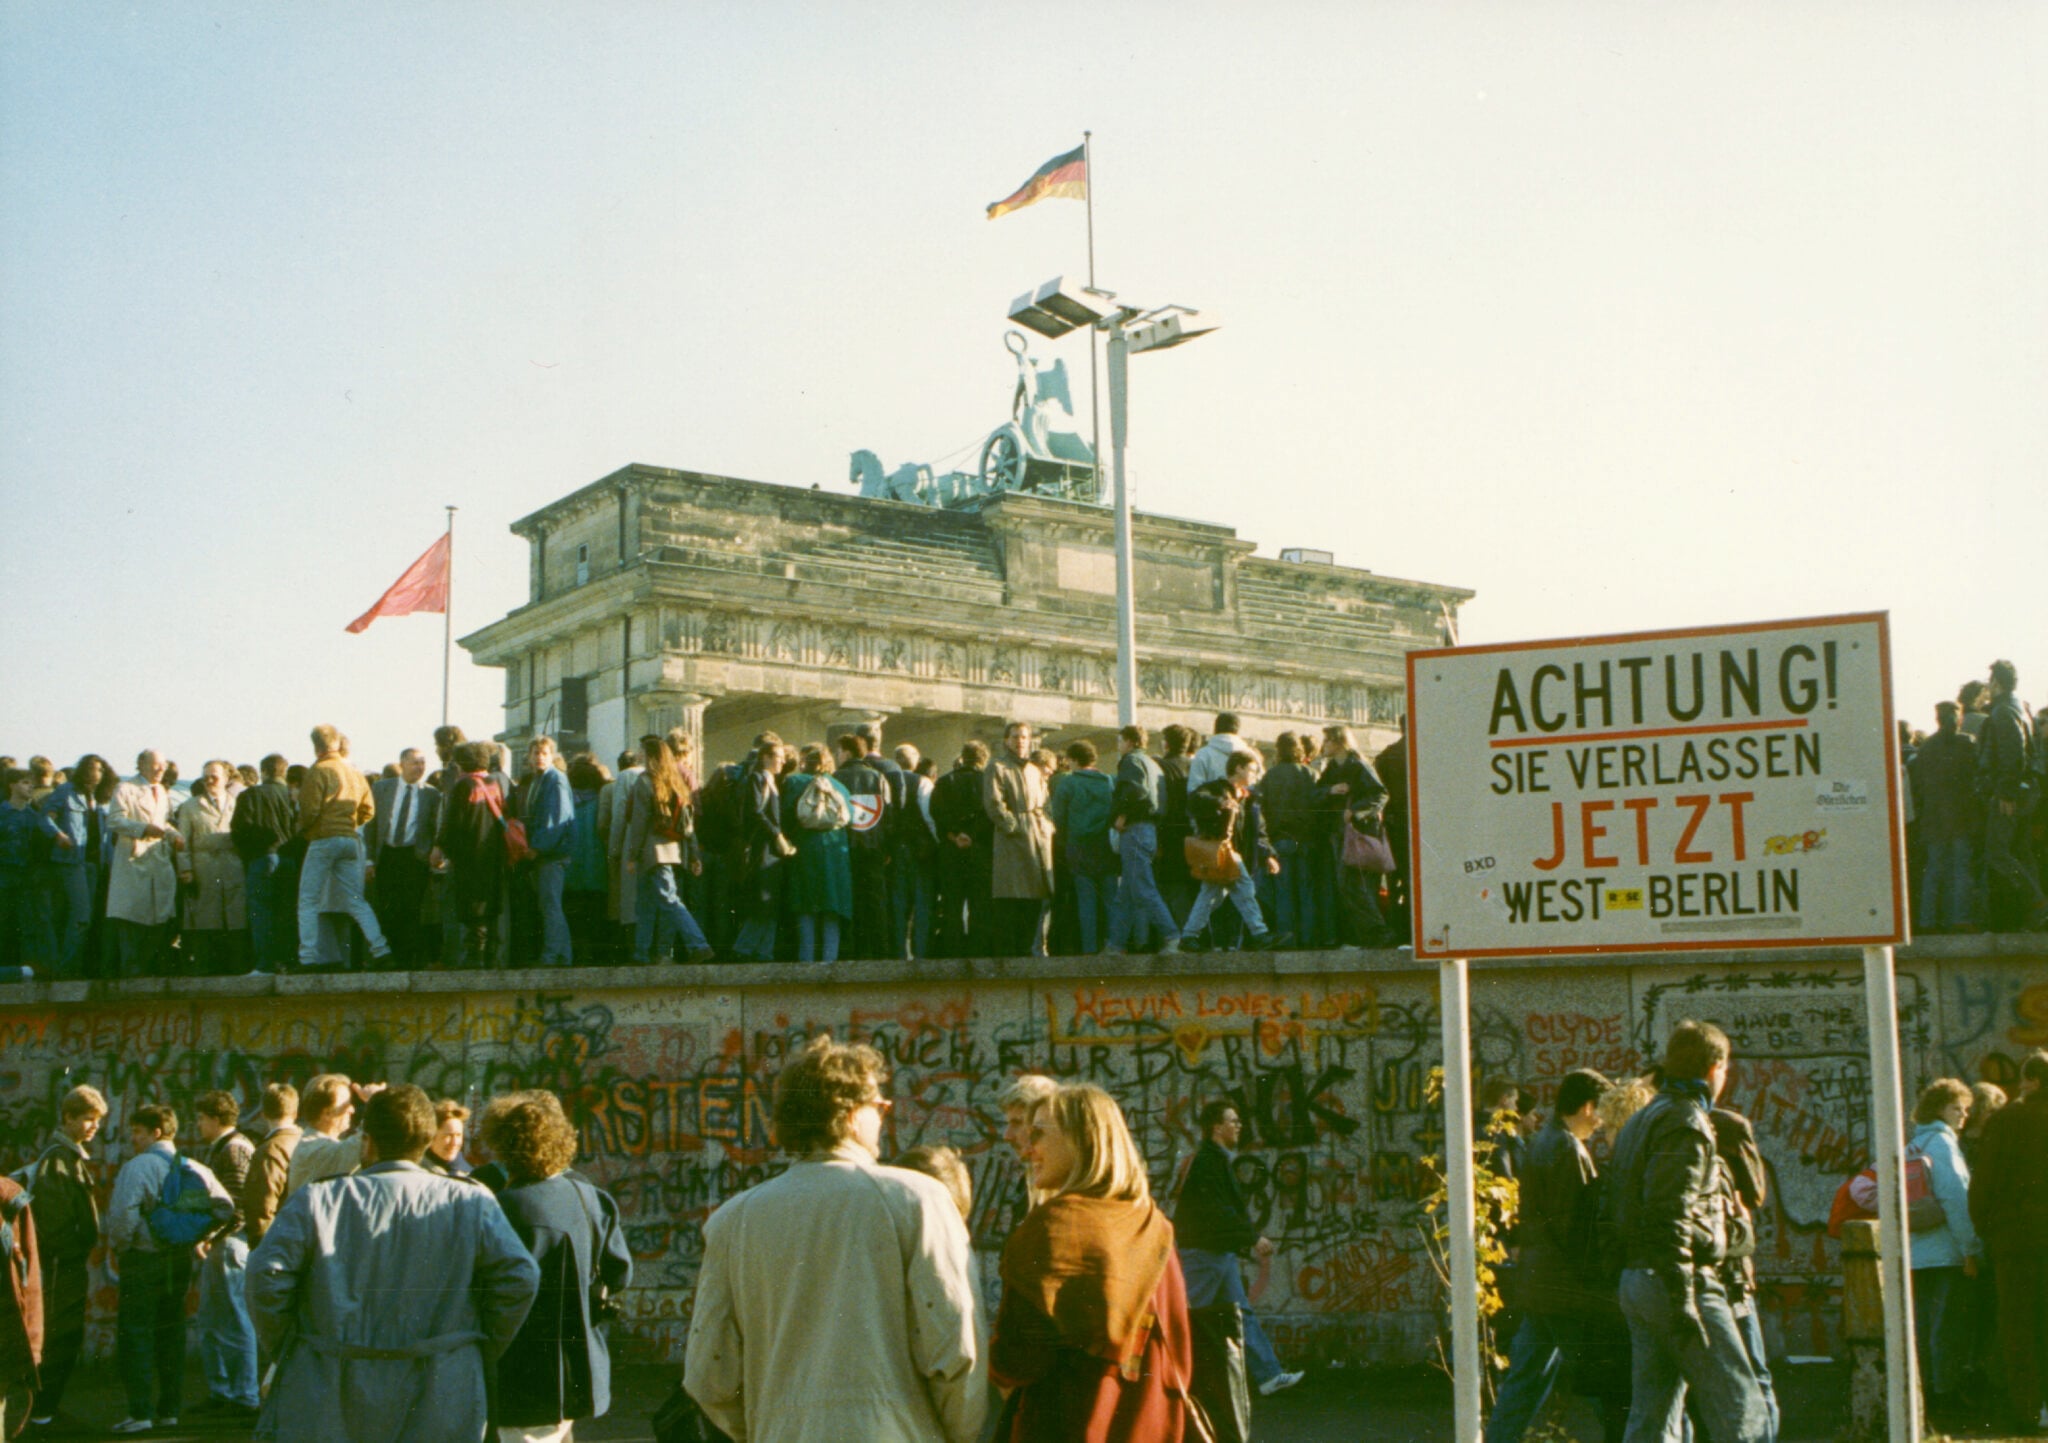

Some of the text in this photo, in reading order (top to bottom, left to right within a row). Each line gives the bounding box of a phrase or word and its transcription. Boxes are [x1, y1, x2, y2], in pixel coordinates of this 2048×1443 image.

[1488, 640, 1838, 735] ACHTUNG!
[1490, 732, 1822, 795] SIE VERLASSEN
[1532, 792, 1755, 871] JETZT
[1464, 856, 1496, 873] BXD
[1503, 877, 1606, 924] WEST
[1649, 869, 1799, 919] BERLIN
[1074, 987, 1184, 1030] KEVIN
[1196, 989, 1288, 1018] LOVES
[1526, 1011, 1625, 1047] CLYDE
[1535, 1046, 1642, 1077] SPICER
